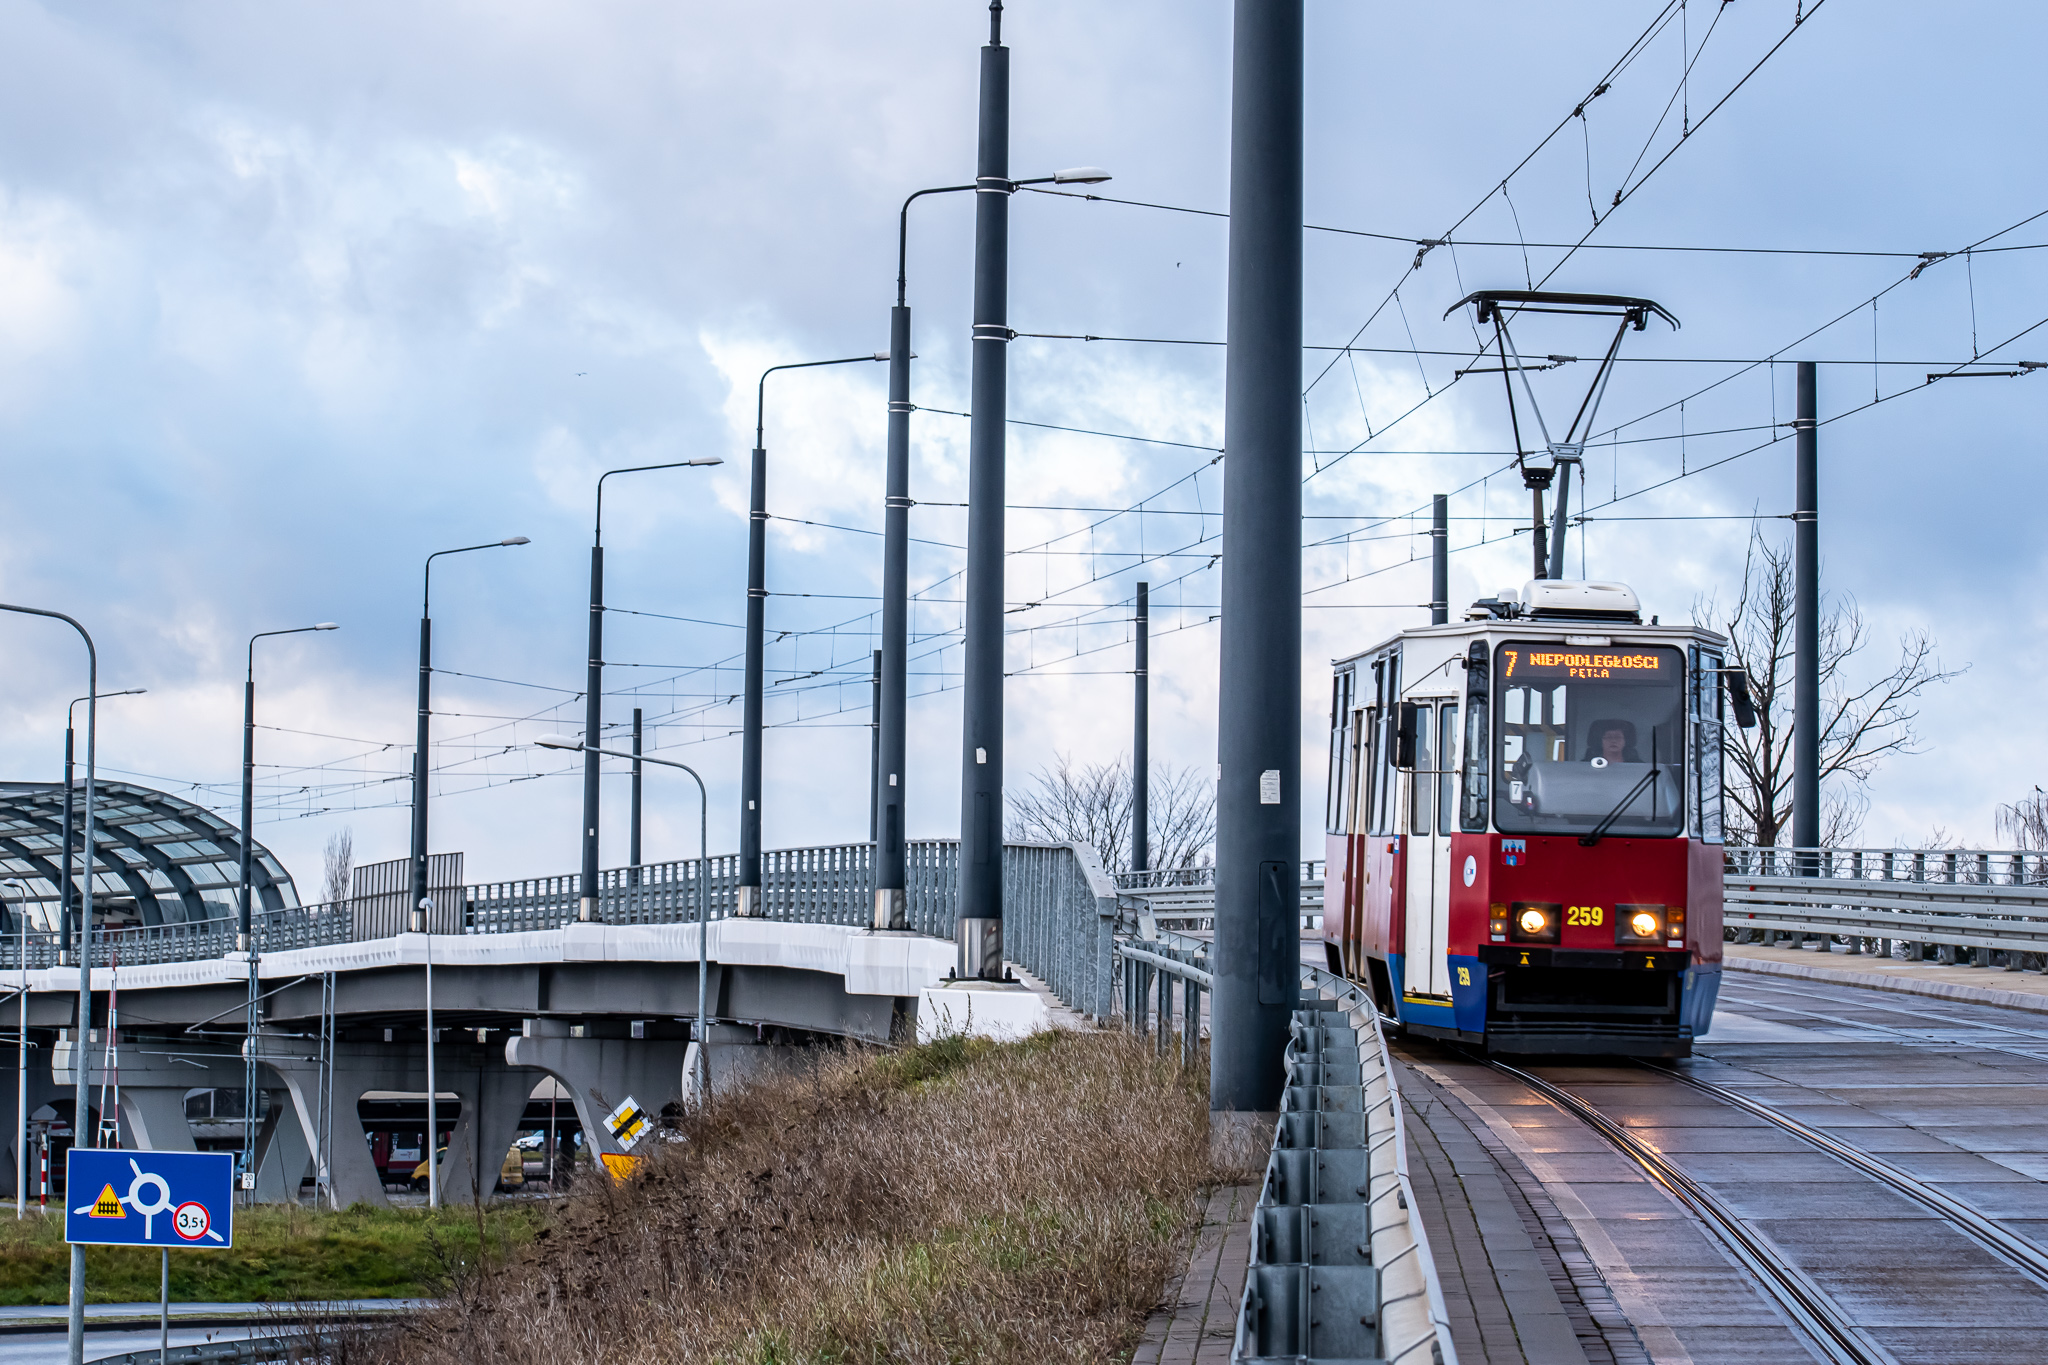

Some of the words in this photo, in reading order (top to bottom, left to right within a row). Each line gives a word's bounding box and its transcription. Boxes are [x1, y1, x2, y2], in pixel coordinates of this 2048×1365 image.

[1505, 651, 1518, 677] 7
[1529, 653, 1659, 669] NIEPODLEGŁOŚCI
[1513, 784, 1520, 795] 7
[1567, 906, 1604, 927] 259
